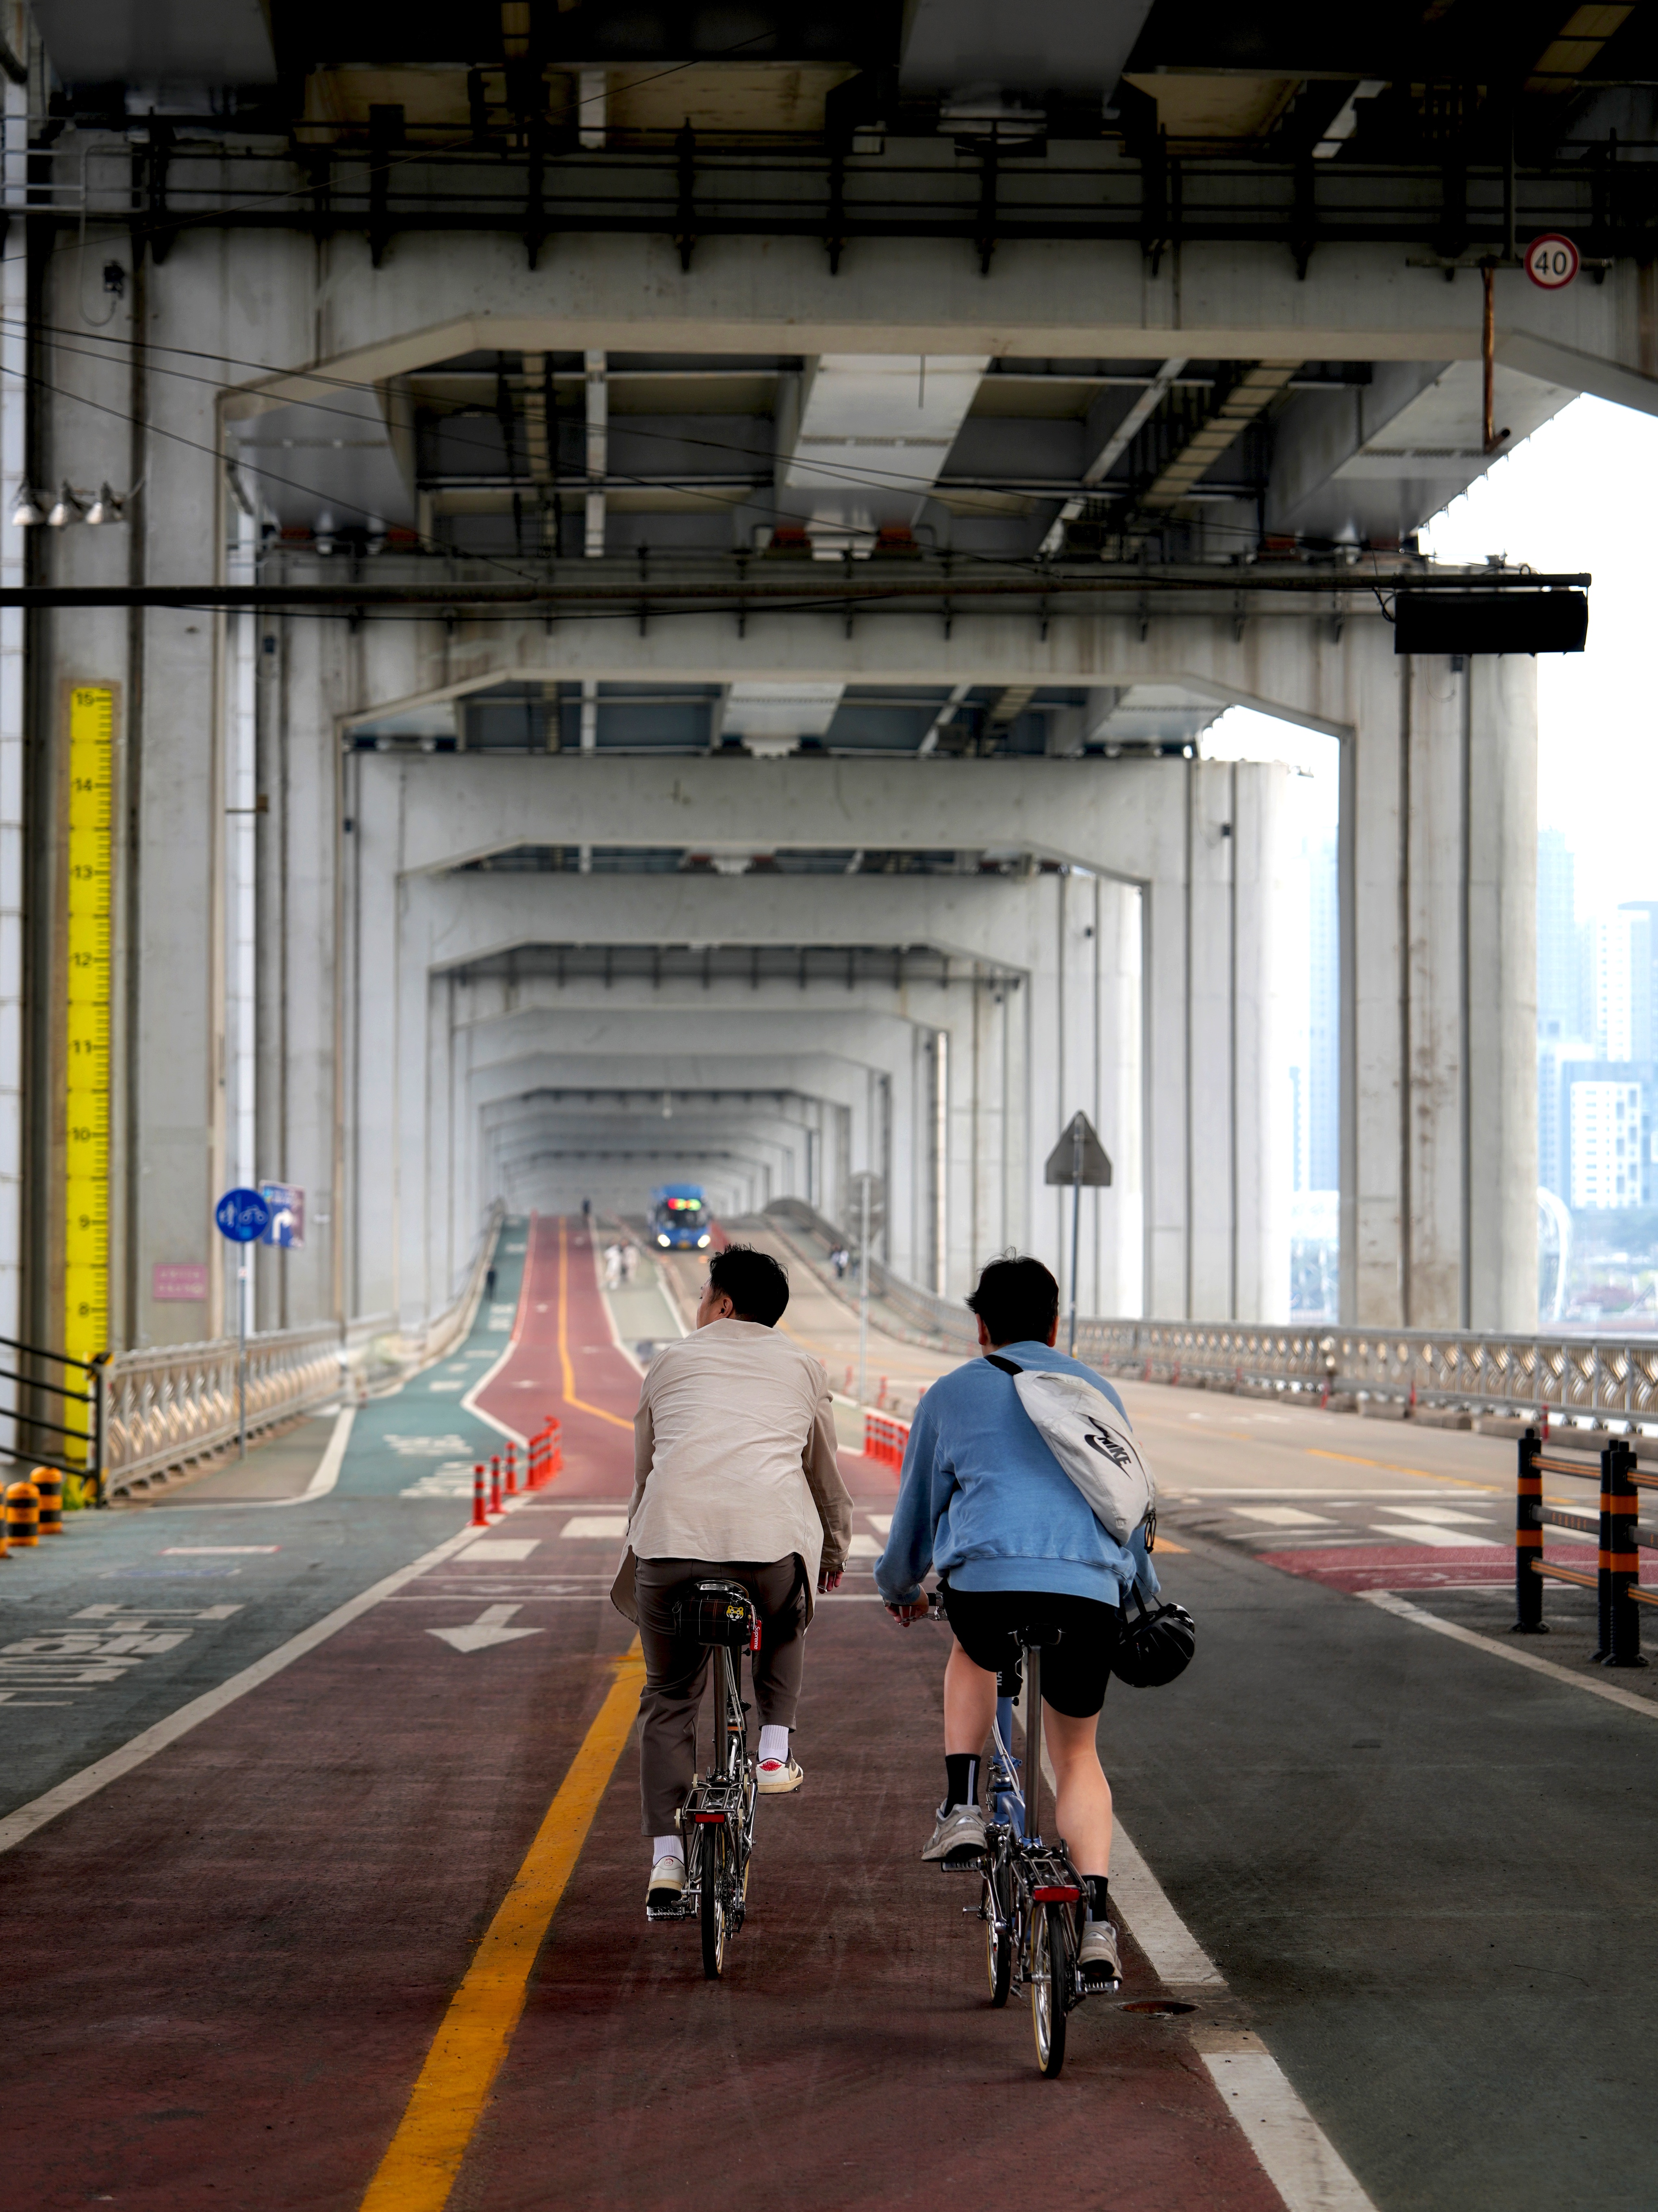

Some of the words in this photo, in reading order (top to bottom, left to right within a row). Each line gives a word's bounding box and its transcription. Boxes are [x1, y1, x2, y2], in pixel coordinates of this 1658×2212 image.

[1535, 250, 1567, 276] 40
[76, 691, 94, 706] 15
[74, 777, 93, 792] 14
[74, 865, 92, 881] 13
[74, 952, 92, 968] 12
[74, 1040, 91, 1055] 11
[73, 1127, 90, 1143] 10
[79, 1215, 91, 1231] 9
[1097, 1437, 1132, 1466] NIKE
